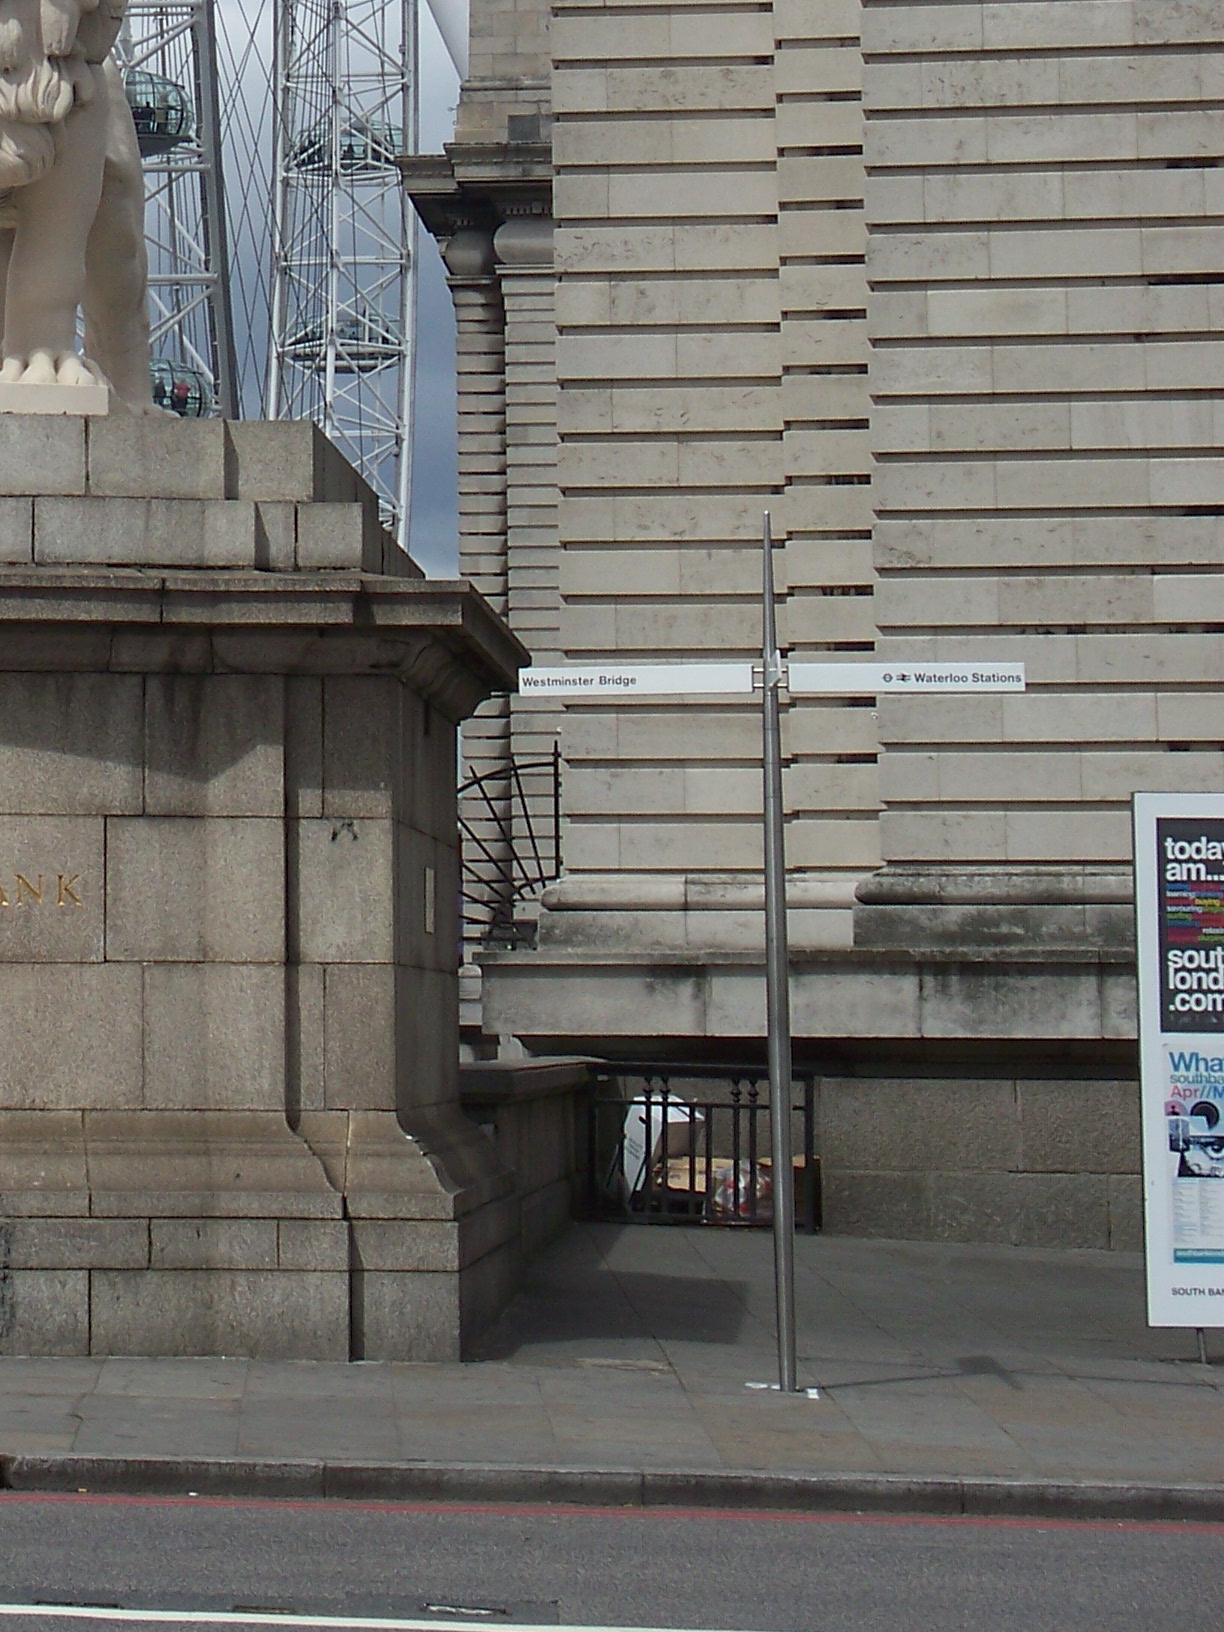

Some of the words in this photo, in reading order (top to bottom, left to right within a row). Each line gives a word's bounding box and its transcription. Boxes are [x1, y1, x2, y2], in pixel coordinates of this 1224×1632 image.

[522, 671, 594, 687] Westminster
[599, 670, 637, 687] Bridge
[914, 672, 969, 683] Waterloo
[971, 672, 1022, 684] Stations
[1171, 1287, 1205, 1296] SOUTH
